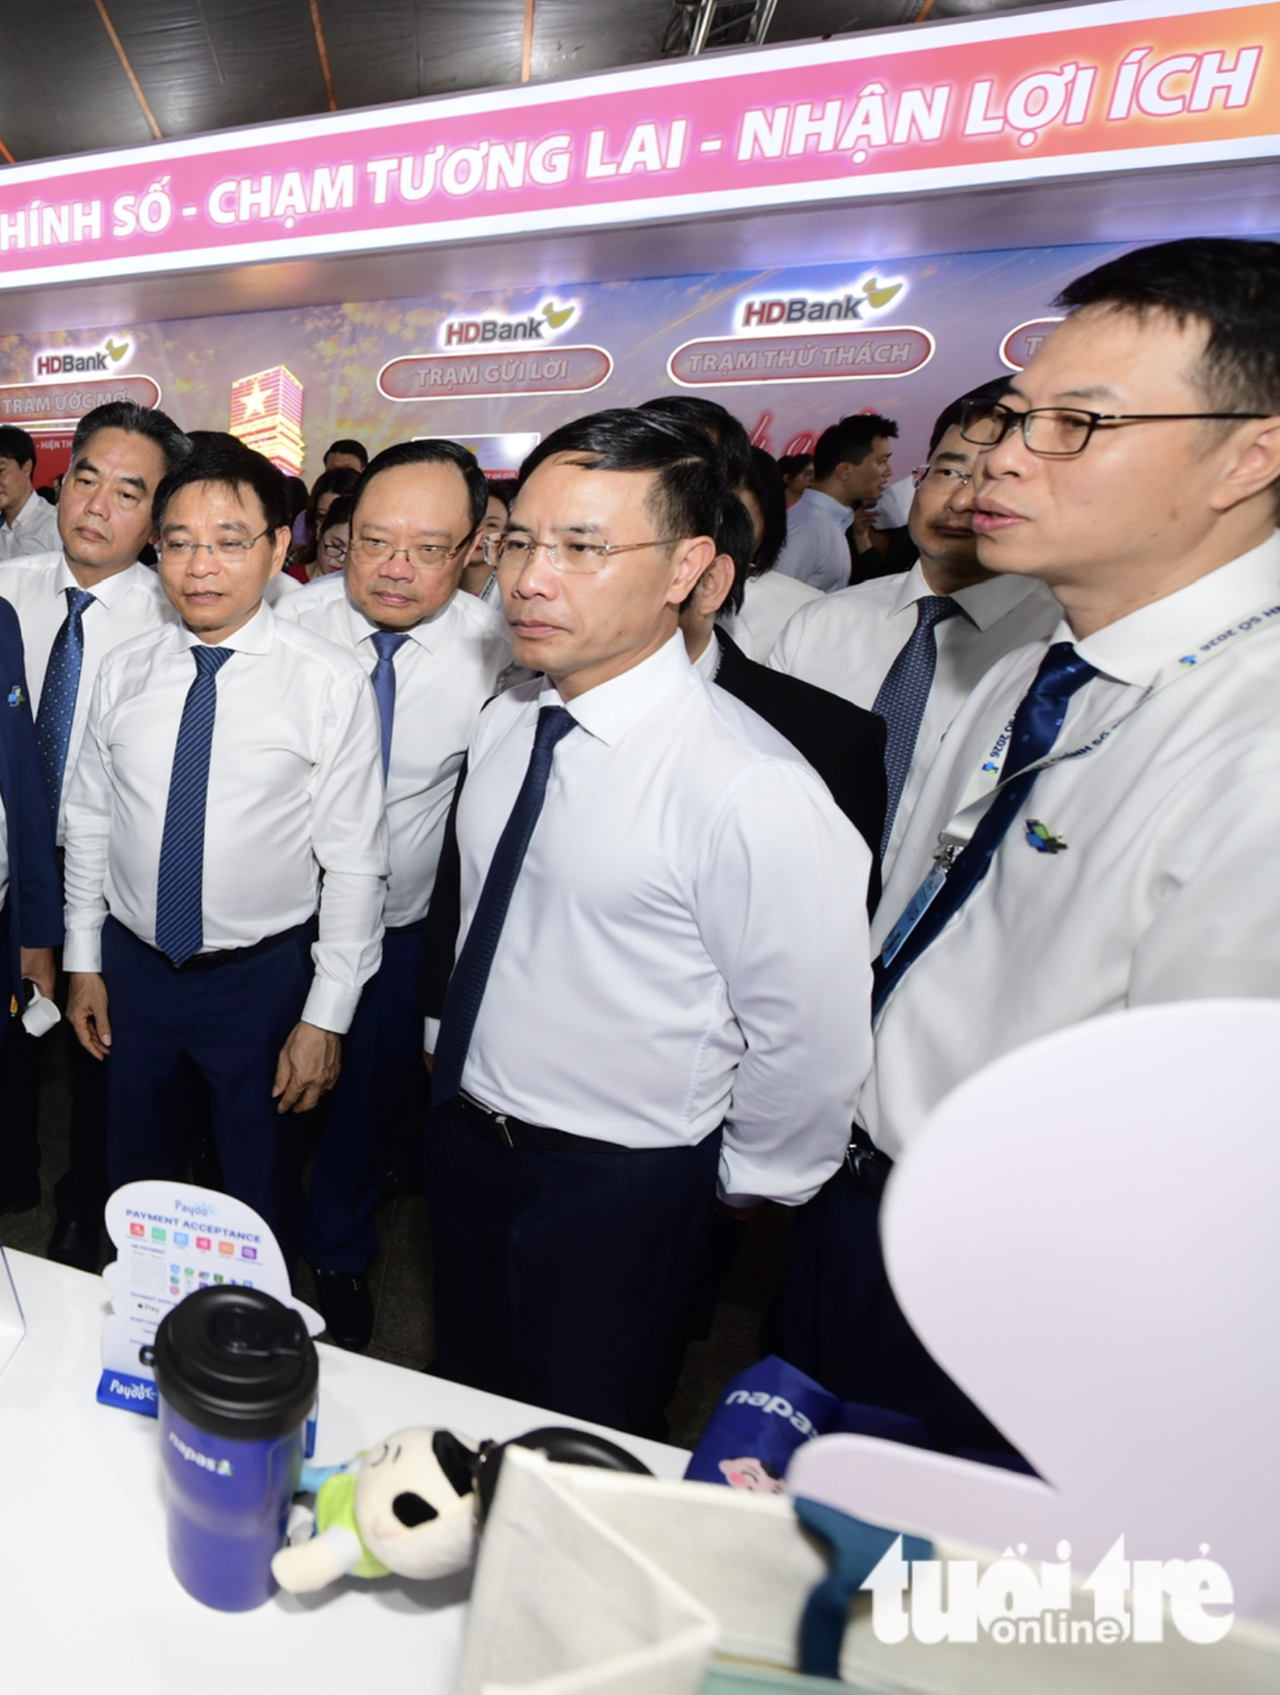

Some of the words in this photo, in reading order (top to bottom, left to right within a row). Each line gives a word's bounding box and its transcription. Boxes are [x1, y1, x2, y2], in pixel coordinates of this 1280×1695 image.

[113, 176, 171, 236] SỐ
[209, 164, 355, 228] CHẠM
[366, 135, 570, 203] TƯƠNG
[586, 120, 686, 178] LAI
[738, 84, 950, 163] NHẬN
[965, 67, 1096, 146] LỢI
[1109, 46, 1263, 120] ÍCH
[743, 295, 863, 326] HDBank
[444, 317, 545, 346] HDBank
[37, 352, 108, 376] HDBank
[687, 350, 757, 376] TRẠM
[763, 343, 817, 369] THỬ
[821, 340, 912, 367] THÁCH
[416, 366, 479, 390] TRẠM
[483, 358, 525, 383] GỬI
[530, 357, 569, 380] LỜI
[3, 396, 50, 417] TRẠM
[55, 391, 92, 414] ƯỚC
[990, 734, 1009, 759] 2026
[174, 1200, 208, 1217] Payoo
[126, 1209, 180, 1226] PAYMENT
[182, 1219, 261, 1243] ACCEPTANCE
[110, 1379, 145, 1400] Payoo
[169, 1431, 216, 1472] napas
